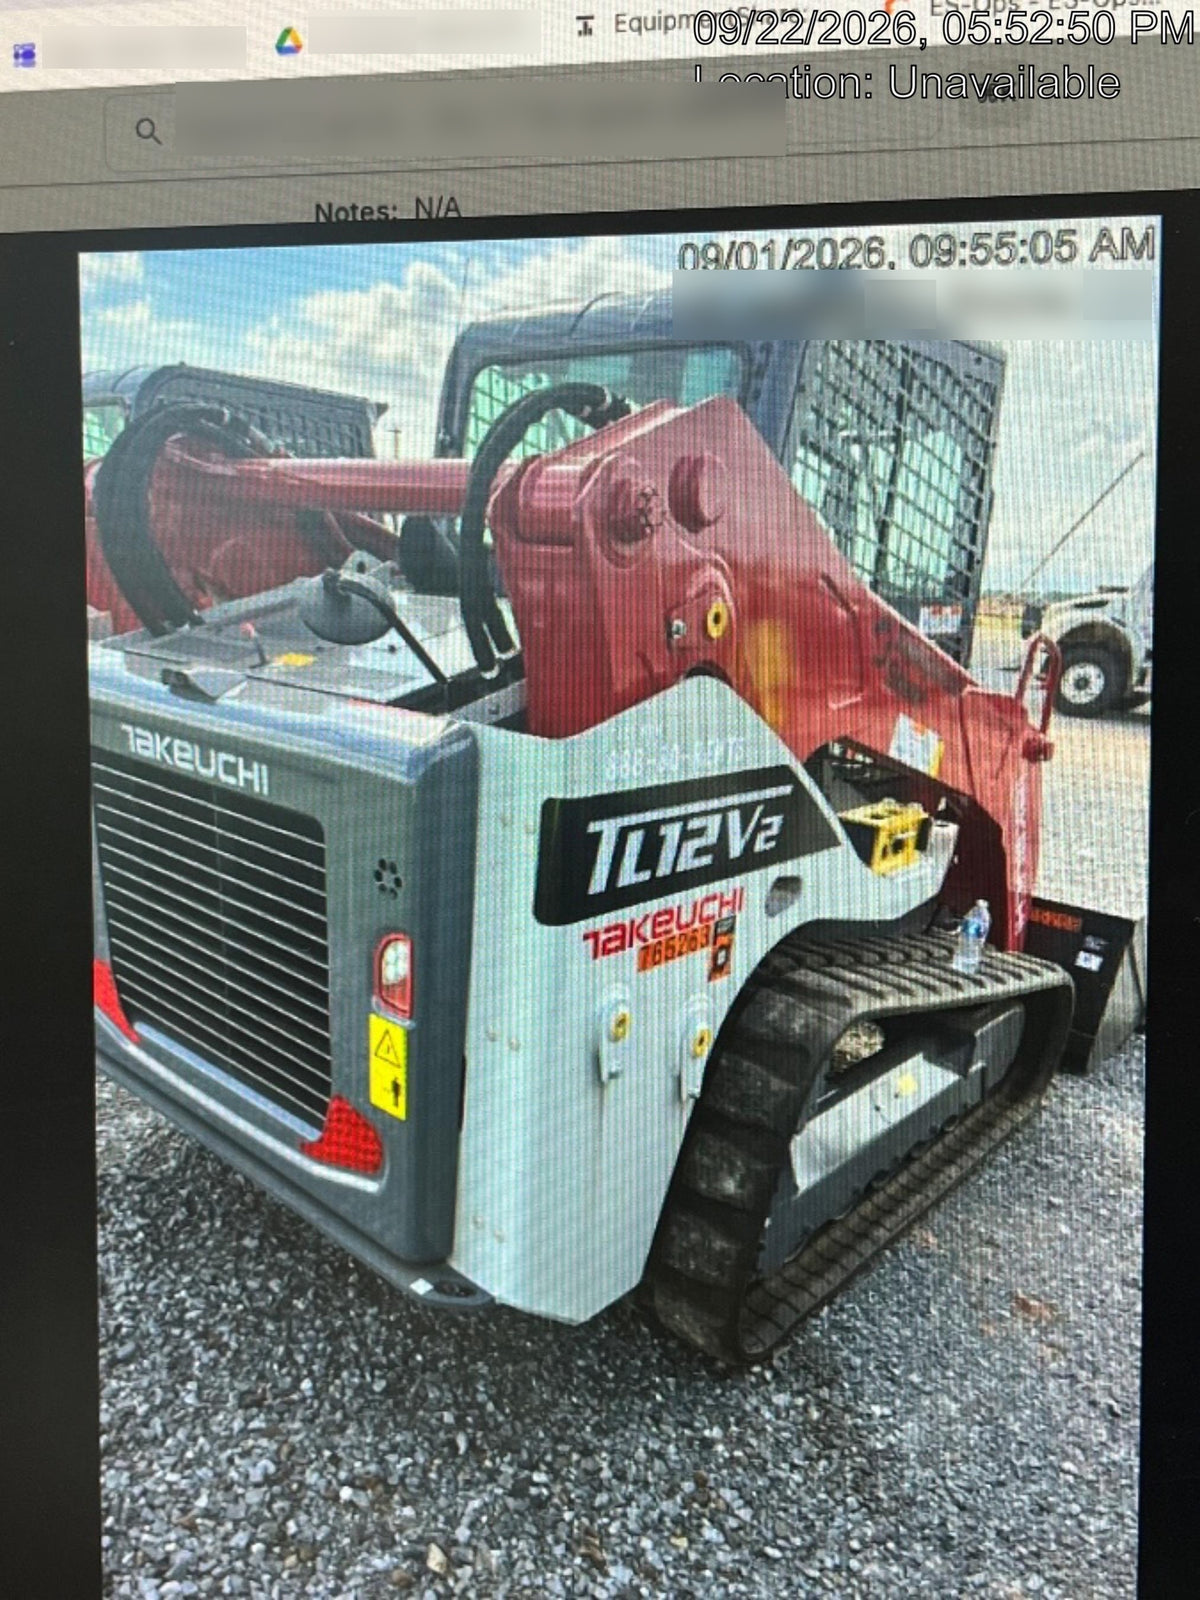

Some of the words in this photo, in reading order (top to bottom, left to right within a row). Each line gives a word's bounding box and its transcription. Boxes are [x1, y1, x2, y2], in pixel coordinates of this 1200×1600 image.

[315, 201, 399, 222] Notes:
[415, 195, 462, 219] N/A
[678, 236, 897, 270] 09/01/2026,
[909, 228, 1078, 268] 09:55:05
[1088, 226, 1156, 263] AM
[120, 722, 269, 796] TAKEUCHI
[583, 887, 744, 960] TAKEUCHI
